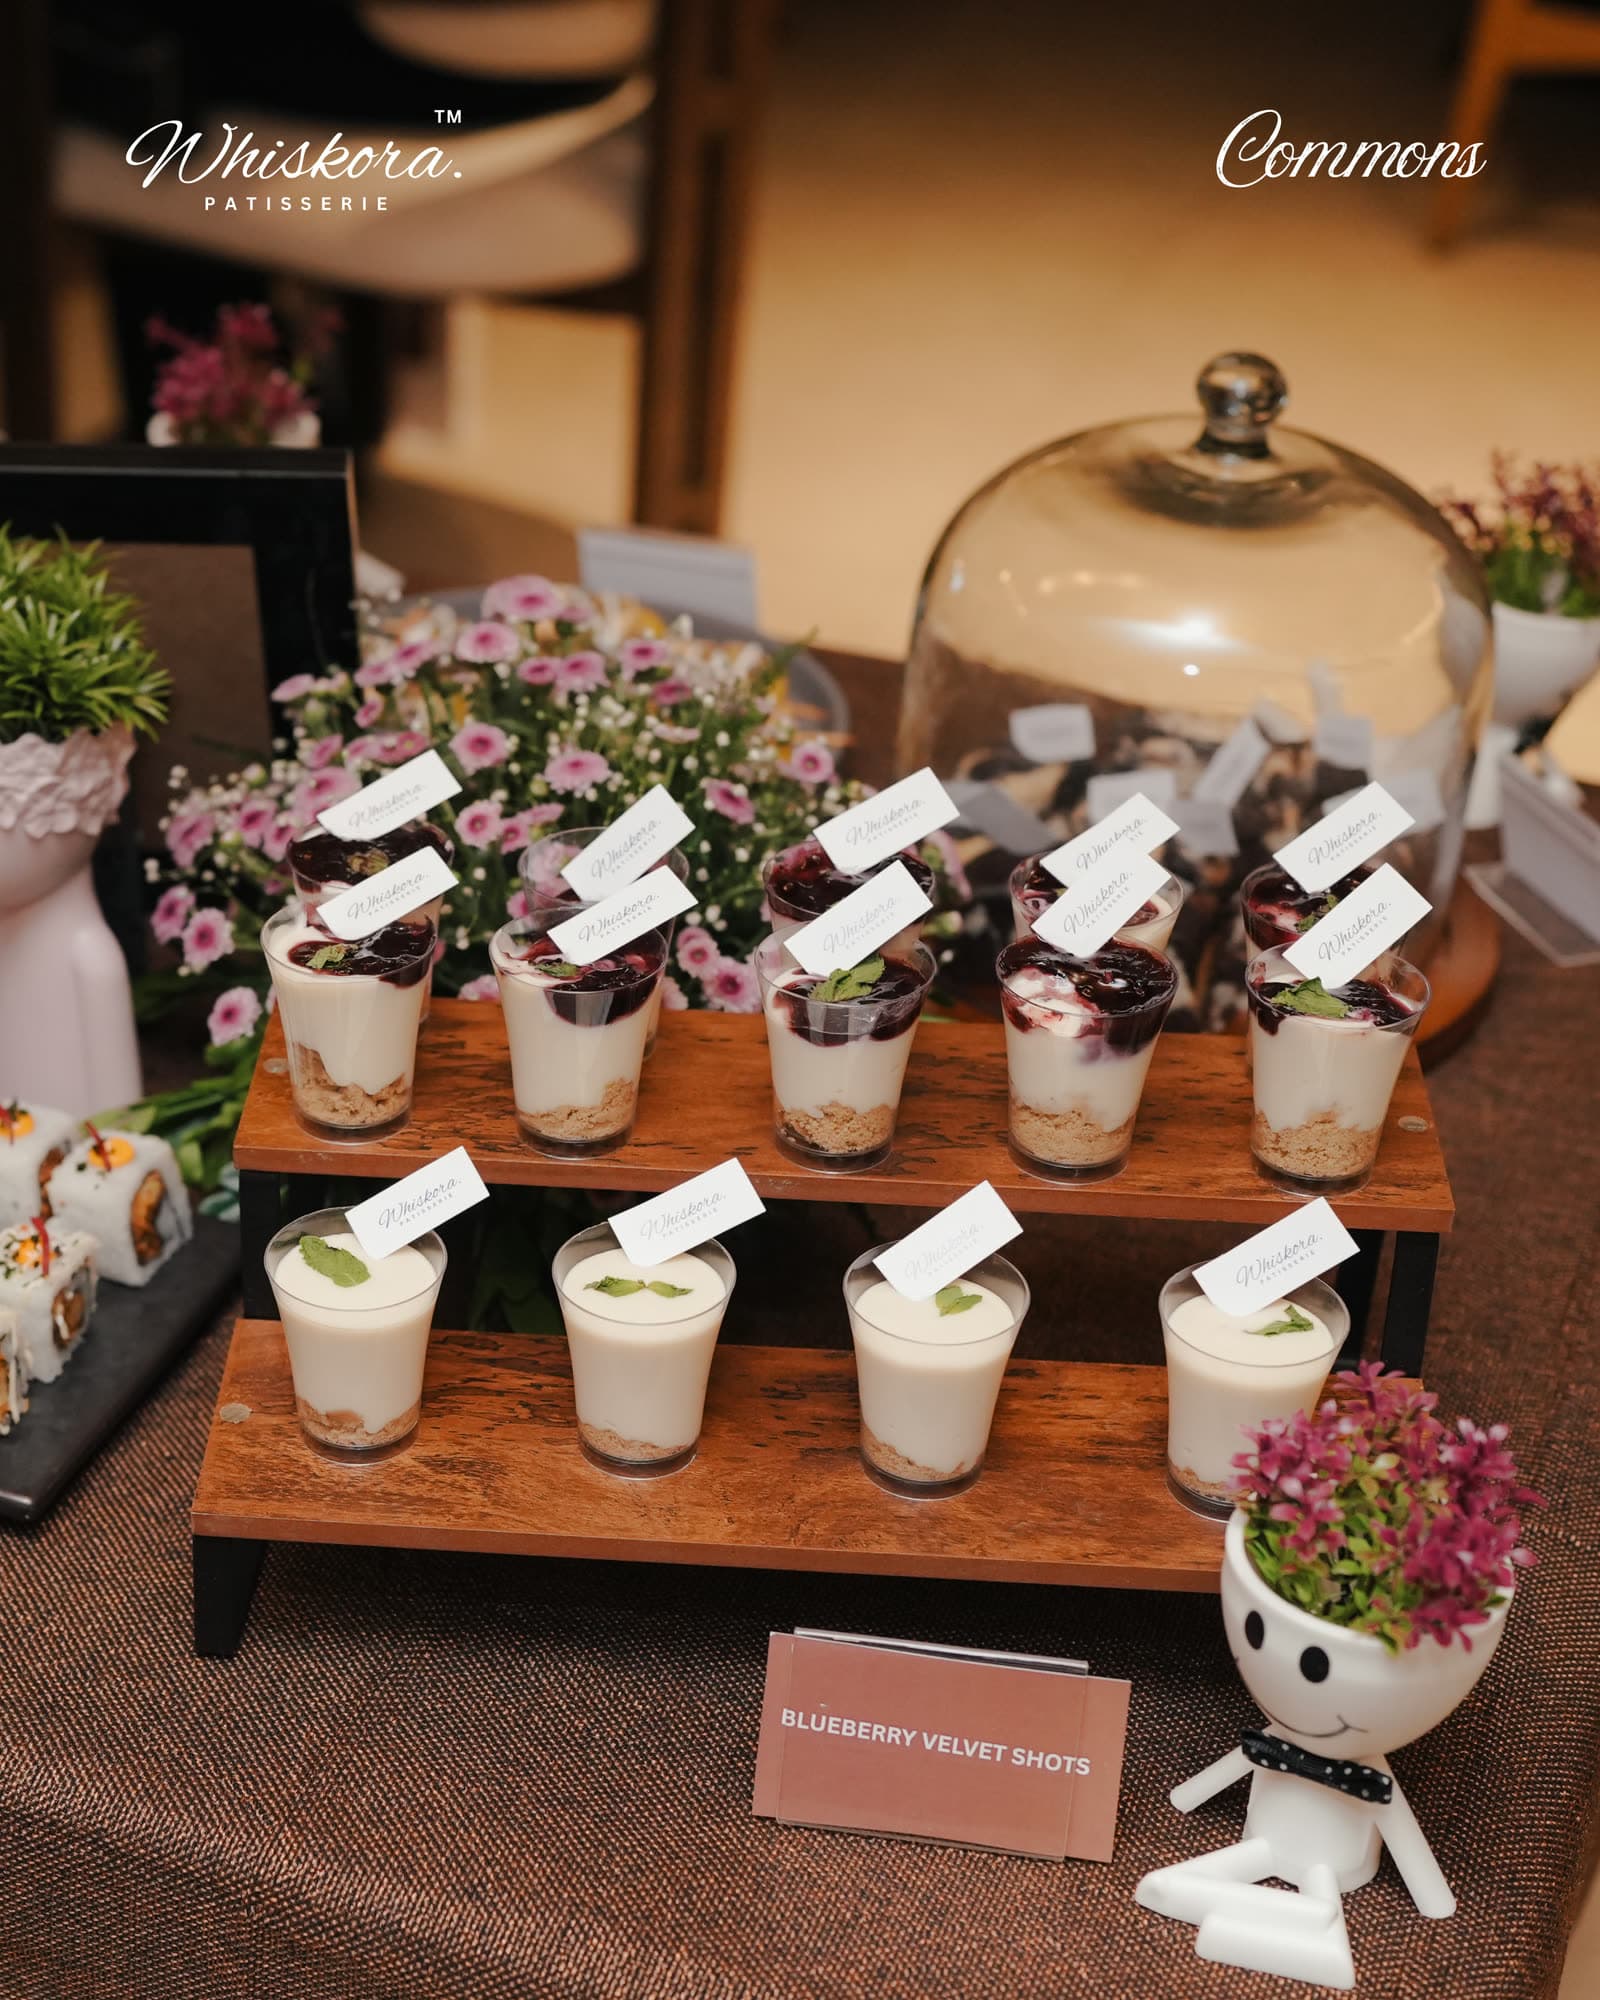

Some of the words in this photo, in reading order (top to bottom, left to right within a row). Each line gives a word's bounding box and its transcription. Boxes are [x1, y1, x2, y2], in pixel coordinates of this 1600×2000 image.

[781, 1708, 917, 1747] BLUEBERRY
[922, 1732, 1007, 1762] VELVET
[1011, 1747, 1091, 1776] SHOTS
